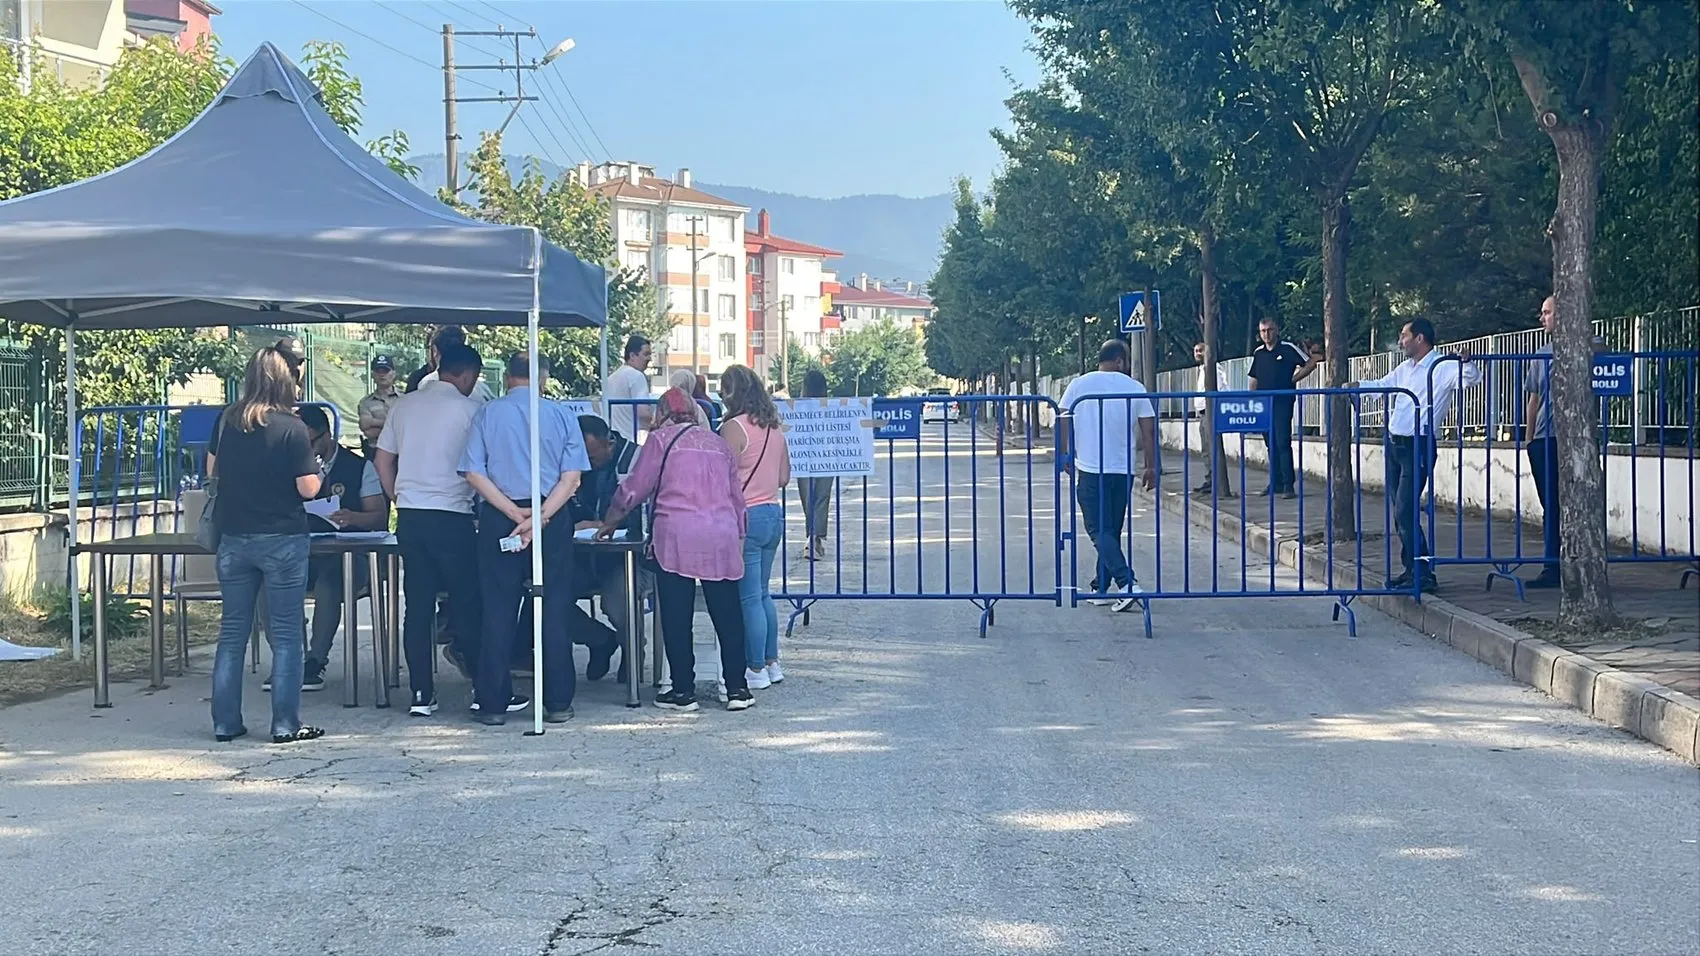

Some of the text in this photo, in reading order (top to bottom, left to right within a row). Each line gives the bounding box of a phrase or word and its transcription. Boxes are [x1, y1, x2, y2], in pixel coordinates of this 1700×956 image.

[1593, 363, 1625, 376] OLİS
[1592, 380, 1619, 389] BOLU
[1220, 400, 1264, 414] POLİS
[824, 409, 867, 419] BELİRLENEN
[873, 408, 912, 420] POLİS
[1229, 416, 1257, 425] BOLU
[795, 421, 851, 432] İZLEYİCİ LİSTESİ
[788, 435, 860, 446] HARİCİNDE DURUŞMA
[790, 448, 863, 458] ALONUNA KESİNLİKLE
